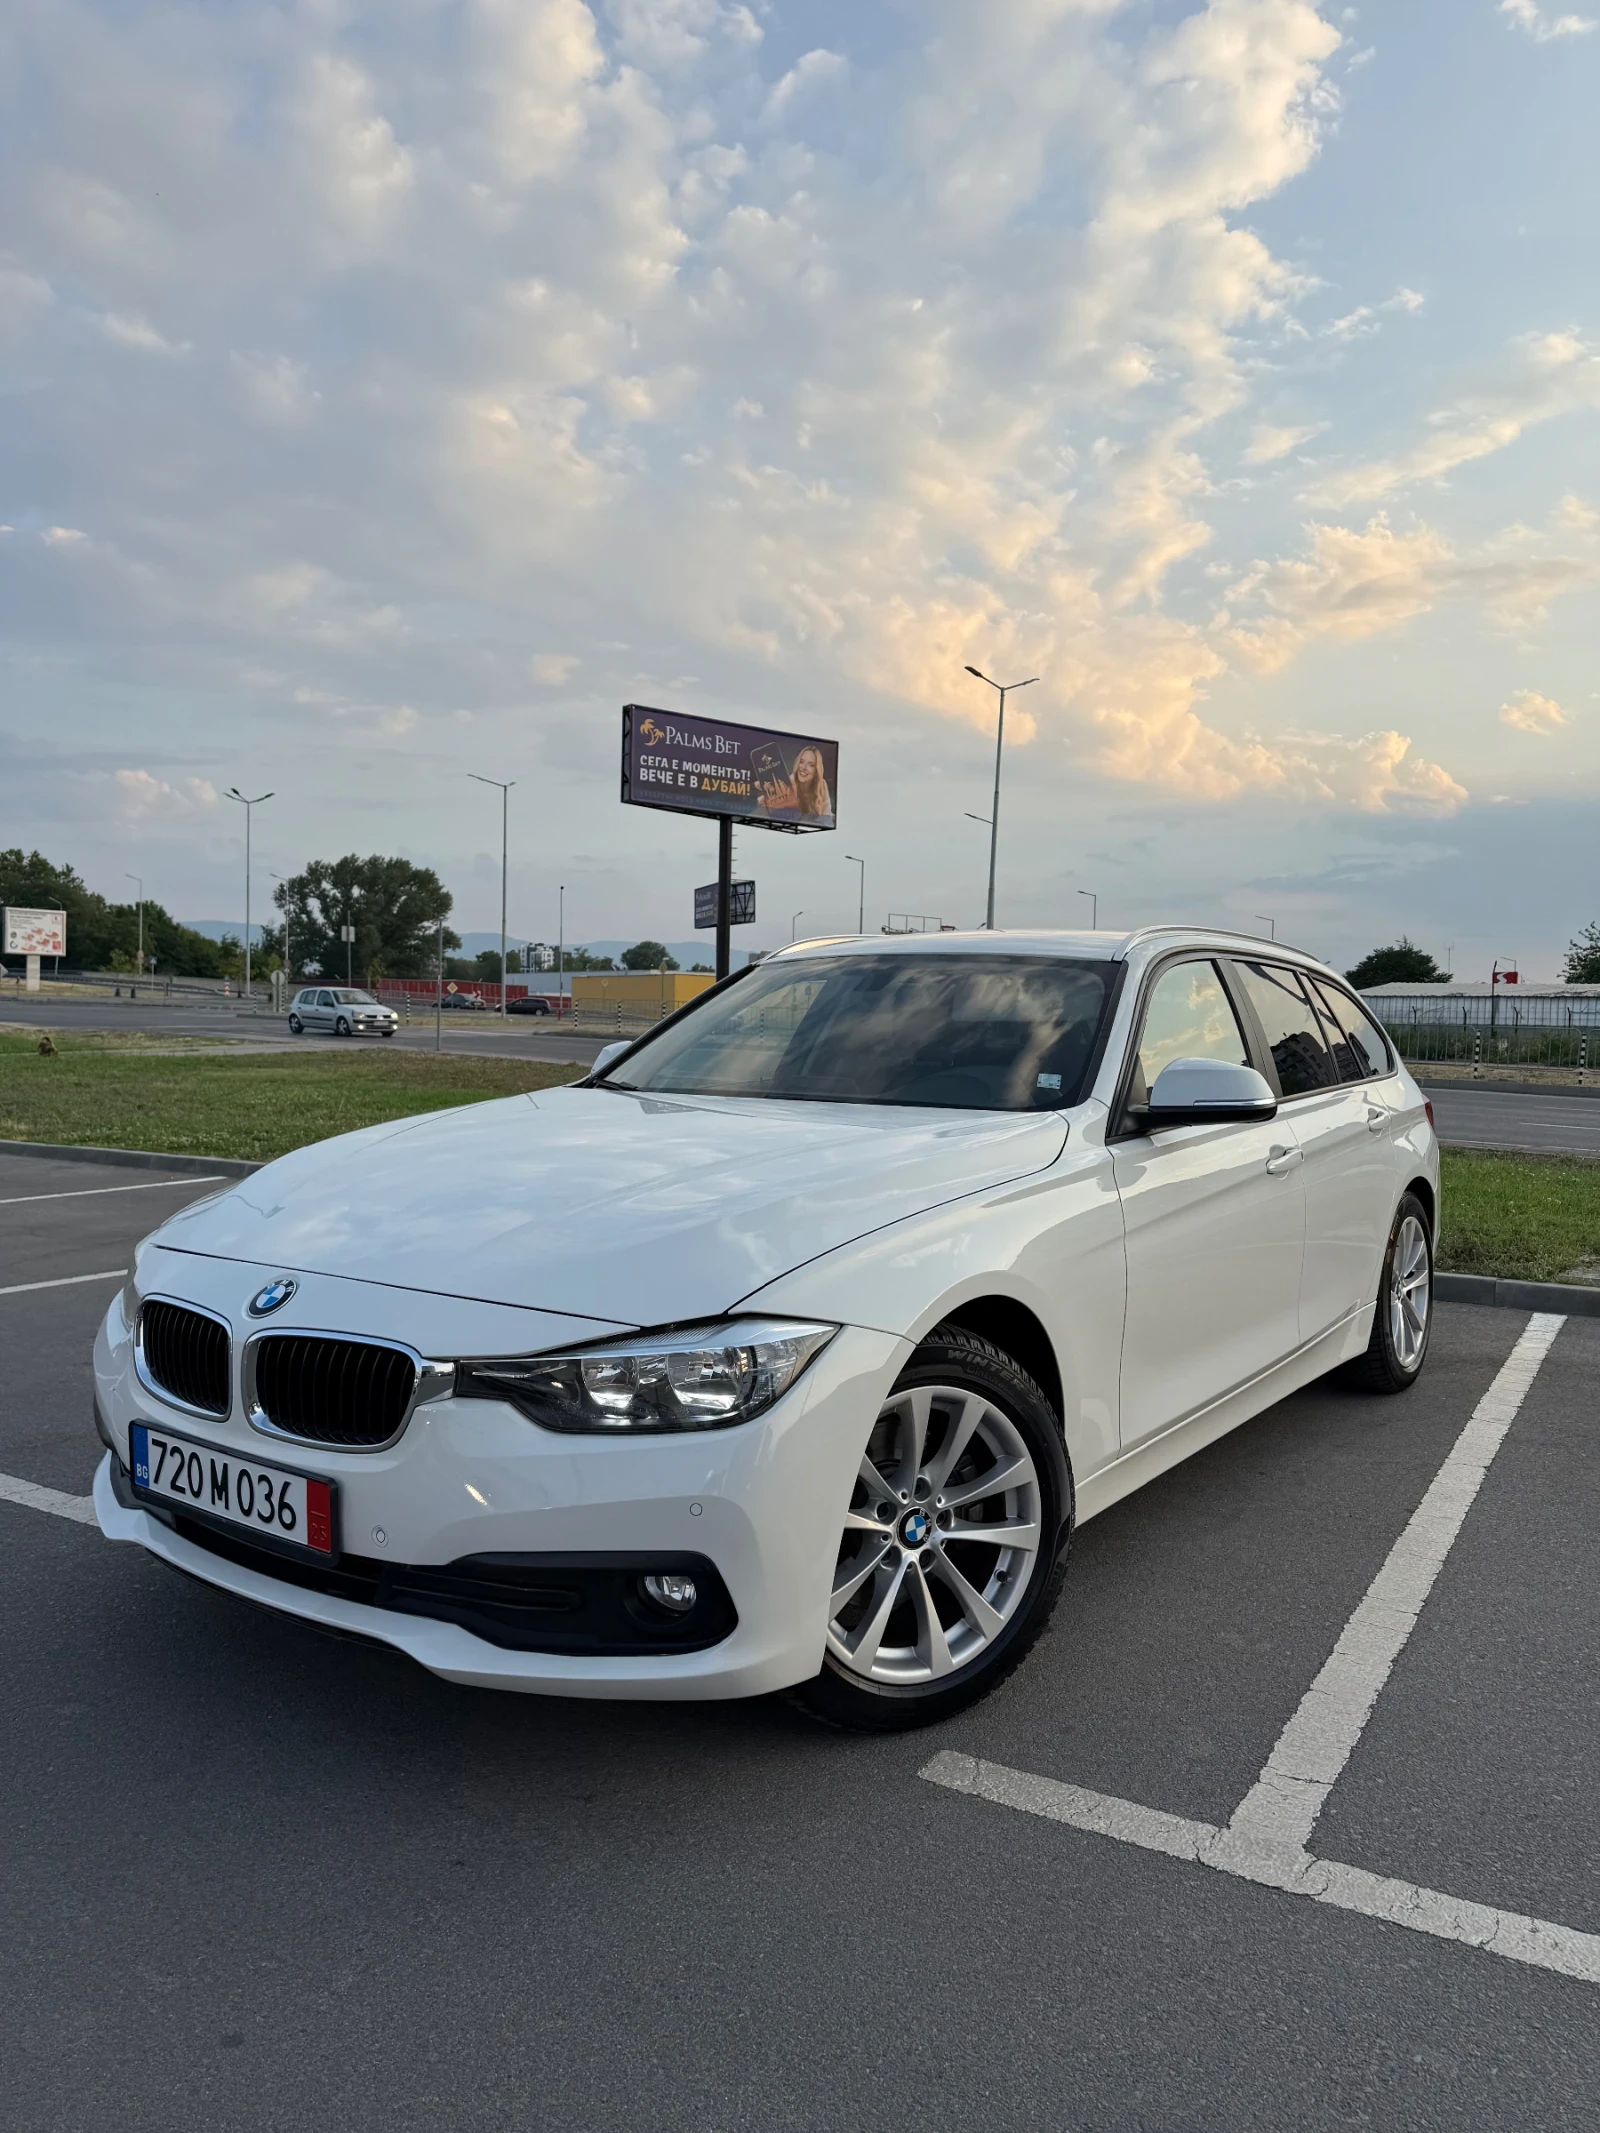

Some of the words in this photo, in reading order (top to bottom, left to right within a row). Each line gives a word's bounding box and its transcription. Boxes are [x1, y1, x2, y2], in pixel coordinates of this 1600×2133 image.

[665, 725, 712, 750] PALMS
[714, 734, 741, 755] BET
[640, 755, 668, 768] СЕГА
[672, 759, 679, 770] Е
[682, 761, 751, 781] МОМЕНТЪТ!
[640, 768, 673, 785] ВЕЧЕ
[678, 773, 685, 786] Е
[690, 776, 698, 788] В
[701, 777, 751, 796] ДУБАЙ!
[947, 1349, 1024, 1391] WINTER
[136, 1463, 149, 1480] BG
[151, 1438, 203, 1499] 720
[210, 1458, 230, 1511] M
[236, 1468, 297, 1531] 036
[311, 1522, 327, 1542] 25
[919, 1508, 932, 1543] BMW
